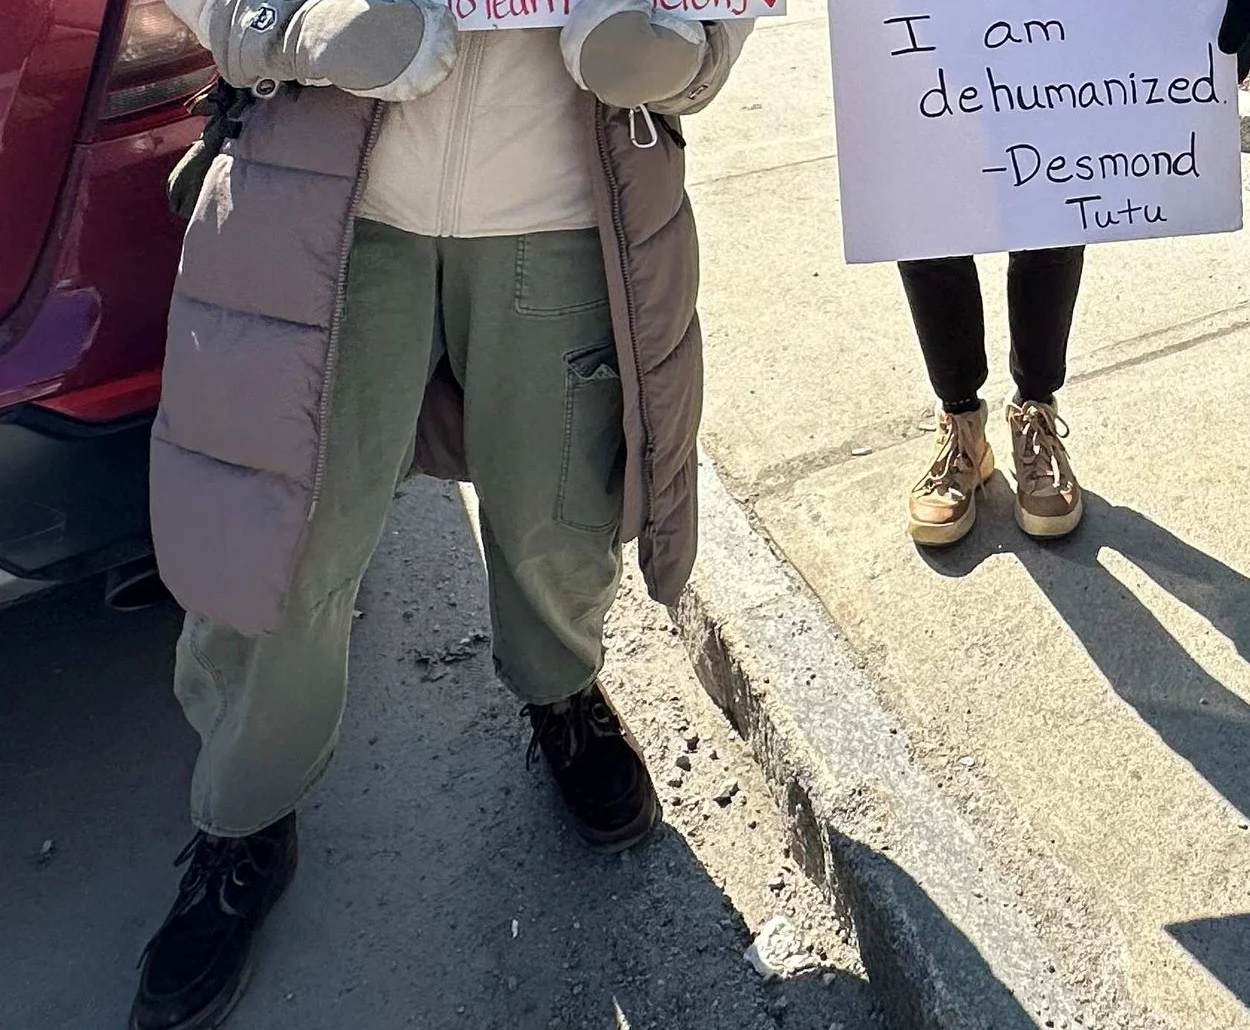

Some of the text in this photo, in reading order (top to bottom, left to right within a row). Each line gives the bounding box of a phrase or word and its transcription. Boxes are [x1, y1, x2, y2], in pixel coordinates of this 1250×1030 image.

[883, 14, 1066, 56] I am
[919, 42, 1228, 119] dehumanized.
[1065, 194, 1168, 231] Tutu
